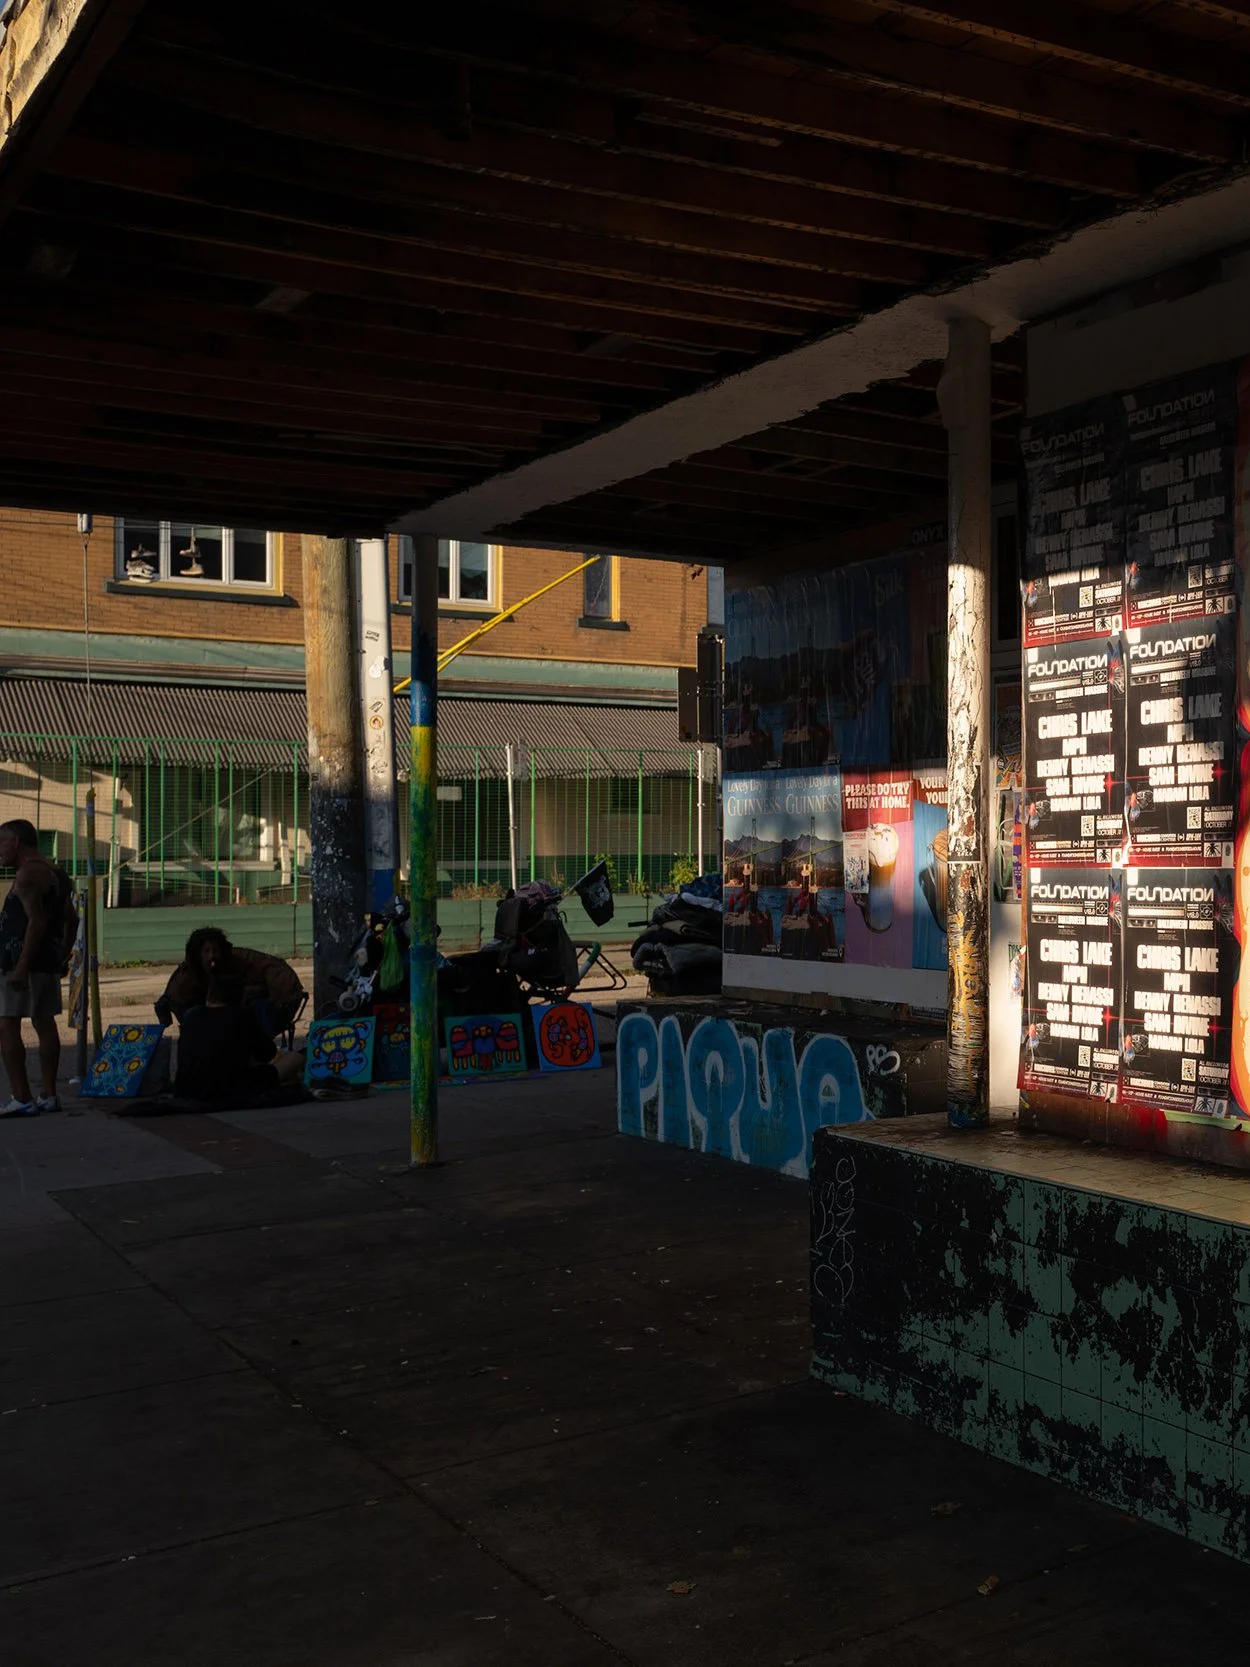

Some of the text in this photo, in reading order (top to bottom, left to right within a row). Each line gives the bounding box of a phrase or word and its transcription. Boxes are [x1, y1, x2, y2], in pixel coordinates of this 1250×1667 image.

[1128, 390, 1215, 428] FOUNDATION
[912, 525, 944, 544] ONYX
[1130, 634, 1217, 659] FOUNDATION
[1028, 654, 1108, 677] FOUNDATION
[1140, 693, 1222, 725] CHRIS LAKE
[1038, 710, 1113, 739] CHRIS LAKE
[1167, 724, 1194, 743] MPH
[1063, 737, 1087, 756] MPH
[727, 779, 749, 793] Lovely
[785, 777, 807, 790] Lovely
[845, 782, 909, 797] PLEASE DO TRY
[727, 797, 782, 817] GUINNESS
[785, 794, 840, 814] GUINNESS
[846, 796, 910, 809] THIS AT HOME.
[1031, 885, 1109, 899] FOUNDATION
[1127, 887, 1214, 901] FOUNDATION
[1040, 939, 1113, 966] CHRIS LAKE
[1137, 945, 1219, 973] CHRIS LAKE
[1062, 965, 1088, 984] MPH
[1164, 973, 1191, 992] MPH
[1046, 1002, 1069, 1021] SAM
[1144, 1012, 1171, 1033] SAM
